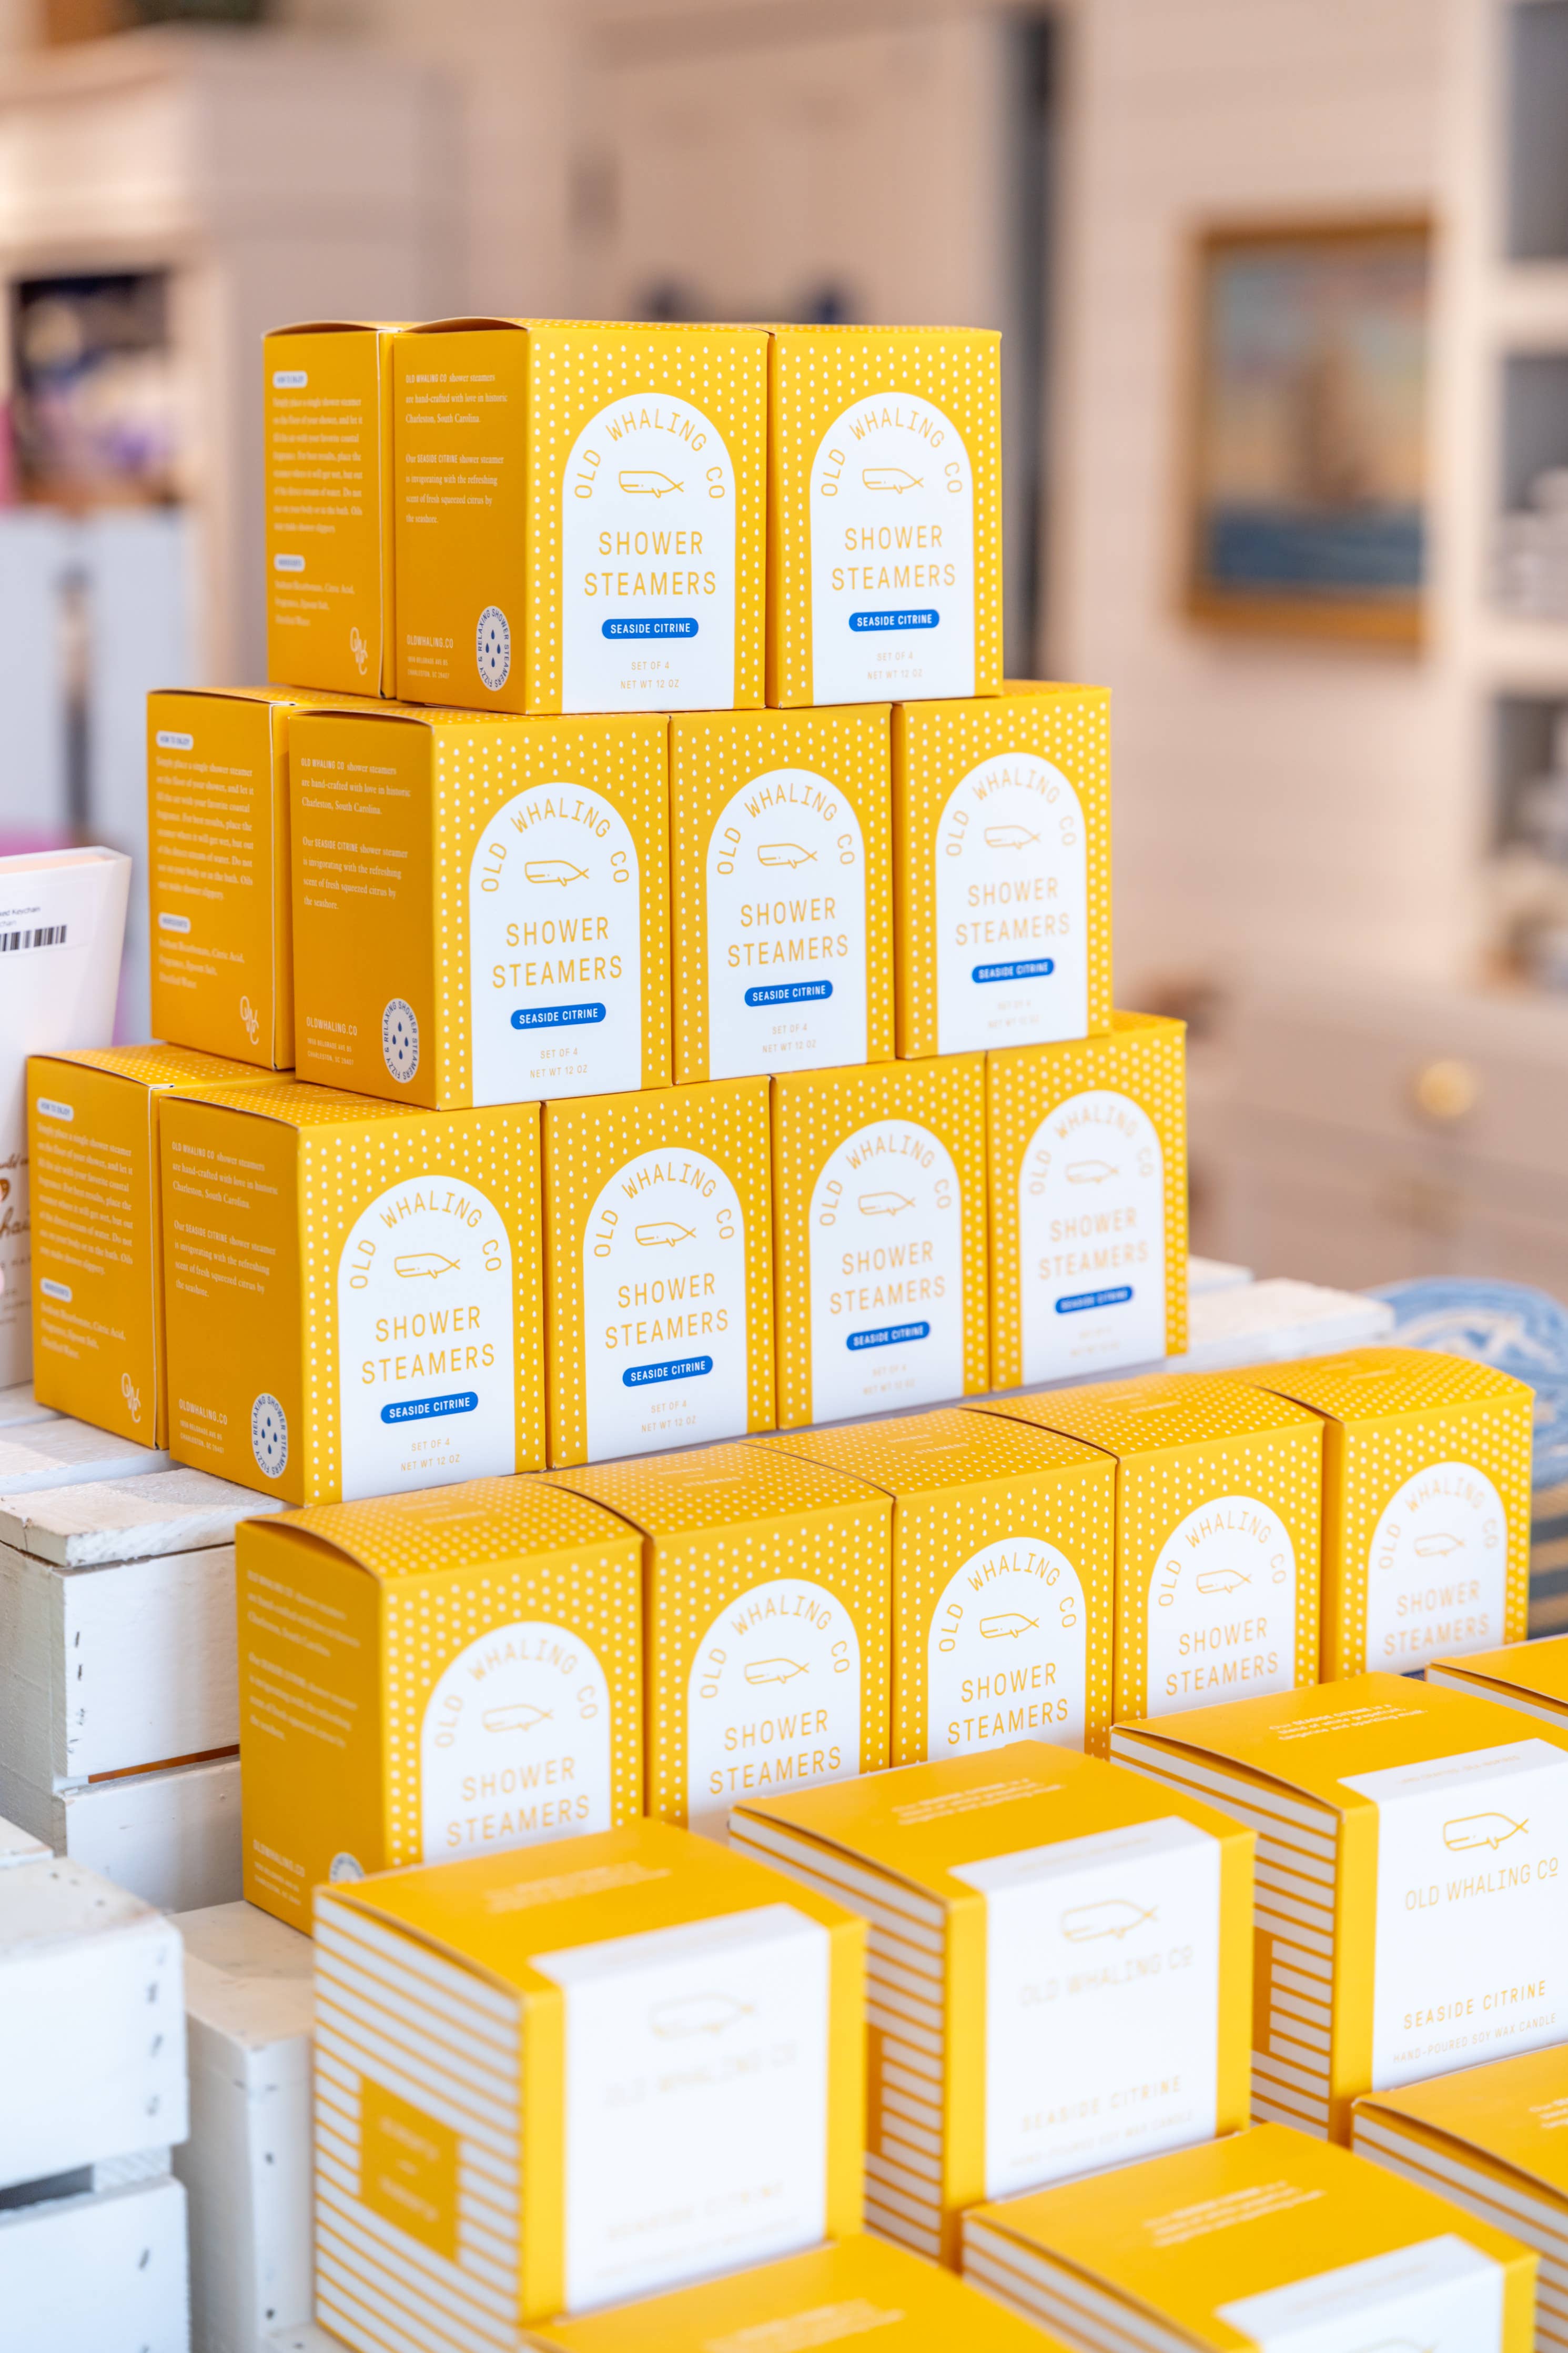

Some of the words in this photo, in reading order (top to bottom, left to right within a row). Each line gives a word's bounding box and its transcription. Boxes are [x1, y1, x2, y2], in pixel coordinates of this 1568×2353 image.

[406, 374, 415, 384] OLD
[417, 374, 438, 384] WHALING
[440, 374, 447, 383] CO
[449, 373, 469, 383] shower
[415, 394, 450, 404] hand-crafted
[451, 393, 463, 403] with
[465, 393, 477, 402] love
[485, 393, 508, 402] historic
[406, 413, 436, 424] Charleston,
[437, 413, 453, 423] South
[454, 413, 480, 423] Carolina.
[406, 453, 416, 463] Our
[417, 454, 437, 464] SEASIDE
[438, 454, 458, 464] CITRINE
[460, 454, 479, 464] shower
[574, 449, 601, 499] OLD
[606, 409, 706, 451] WHALING
[706, 466, 725, 499] CO
[821, 449, 845, 497] OLD
[848, 406, 945, 449] WHALING
[944, 461, 963, 494] CO
[411, 474, 443, 485] invigorating
[444, 474, 456, 484] with
[458, 474, 466, 484] the
[468, 474, 498, 487] refreshing
[420, 494, 426, 503] of
[426, 494, 440, 504] fresh
[441, 495, 466, 506] squeezed
[467, 495, 484, 505] citrus
[485, 495, 493, 507] by
[415, 514, 438, 524] seashore.
[599, 531, 703, 556] SHOWER
[845, 525, 942, 551] SHOWER
[584, 571, 716, 597] STEAMERS
[832, 564, 955, 591] STEAMERS
[478, 609, 491, 651] RELAXING
[492, 608, 509, 640] SHOWER
[610, 624, 651, 634] SEASIDE
[654, 623, 691, 634] CITRINE
[857, 616, 895, 627] SEASIDE
[897, 614, 932, 625] CITRINE
[407, 635, 453, 649] OLDWHALING.CO
[479, 667, 492, 687] FIZZY
[494, 644, 510, 688] STEAMERS
[631, 661, 647, 671] SET
[650, 660, 661, 671] OF
[620, 679, 636, 690] NET
[640, 679, 652, 689] WT
[656, 679, 665, 689] 12
[667, 678, 680, 689] OZ
[717, 827, 741, 875] OLD
[744, 783, 838, 822] WHALING
[837, 833, 856, 866] CO
[946, 810, 969, 857] OLD
[972, 768, 1059, 803] WHALING
[1060, 816, 1077, 847] CO
[481, 842, 507, 892] OLD
[511, 797, 611, 839] WHALING
[610, 851, 630, 883] CO
[968, 877, 1057, 907] SHOWER
[741, 897, 835, 928] SHOWER
[956, 912, 1068, 946] STEAMERS
[507, 916, 608, 947] SHOWER
[728, 934, 848, 968] STEAMERS
[493, 955, 622, 989] STEAMERS
[753, 989, 789, 1002] SEASIDE
[792, 985, 825, 998] CITRINE
[519, 1011, 559, 1024] SEASIDE
[562, 1008, 598, 1021] CITRINE
[530, 1069, 545, 1078] NET
[549, 1067, 562, 1077] WT
[565, 1065, 574, 1075] 12
[576, 1063, 588, 1074] OZ
[541, 1049, 556, 1060] SET
[559, 1048, 570, 1058] OF
[820, 1180, 843, 1226] OLD
[845, 1133, 935, 1170] WHALING
[934, 1178, 952, 1210] CO
[594, 1210, 619, 1258] OLD
[622, 1161, 717, 1199] WHALING
[716, 1208, 735, 1240] CO
[349, 1240, 376, 1289] OLD
[380, 1190, 483, 1229] WHALING
[482, 1239, 502, 1272] CO
[843, 1241, 933, 1276] SHOWER
[618, 1273, 715, 1309] SHOWER
[831, 1276, 945, 1315] STEAMERS
[376, 1306, 480, 1343] SHOWER
[605, 1309, 728, 1349] STEAMERS
[853, 1331, 891, 1346] SEASIDE
[891, 1325, 923, 1340] CITRINE
[362, 1343, 494, 1384] STEAMERS
[631, 1367, 668, 1382] SEASIDE
[671, 1361, 705, 1375] CITRINE
[389, 1403, 430, 1419] SEASIDE
[433, 1397, 470, 1412] CITRINE
[401, 1461, 417, 1472] NET
[420, 1457, 433, 1468] WT
[437, 1456, 446, 1465] 12
[449, 1453, 461, 1464] OZ
[412, 1441, 427, 1452] SET
[431, 1439, 441, 1449] OF
[1158, 1560, 1181, 1607] OLD
[1186, 1511, 1270, 1548] WHALING
[1270, 1553, 1287, 1585] CO
[938, 1603, 964, 1652] OLD
[968, 1553, 1060, 1591] WHALING
[1059, 1596, 1077, 1628] CO
[700, 1648, 726, 1699] OLD
[731, 1594, 833, 1635] WHALING
[831, 1640, 850, 1674] CO
[1179, 1617, 1267, 1656] SHOWER
[962, 1662, 1056, 1703] SHOWER
[1166, 1652, 1278, 1696] STEAMERS
[434, 1695, 463, 1748] OLD
[468, 1639, 577, 1681] WHALING
[577, 1685, 598, 1720] CO
[725, 1709, 828, 1751] SHOWER
[947, 1698, 1068, 1745] STEAMERS
[463, 1756, 574, 1802] SHOWER
[710, 1746, 841, 1795] STEAMERS
[447, 1795, 589, 1847] STEAMERS
[1405, 1885, 1440, 1911] OLD
[1446, 1863, 1531, 1902] WHALING
[1403, 1998, 1474, 2029] SEASIDE
[1482, 1980, 1546, 2010] CITRINE
[1393, 2036, 1468, 2063] HAND-POURED
[1472, 2029, 1491, 2045] SOY
[1494, 2025, 1516, 2039] WAX
[1519, 2013, 1556, 2032] CANDLE
